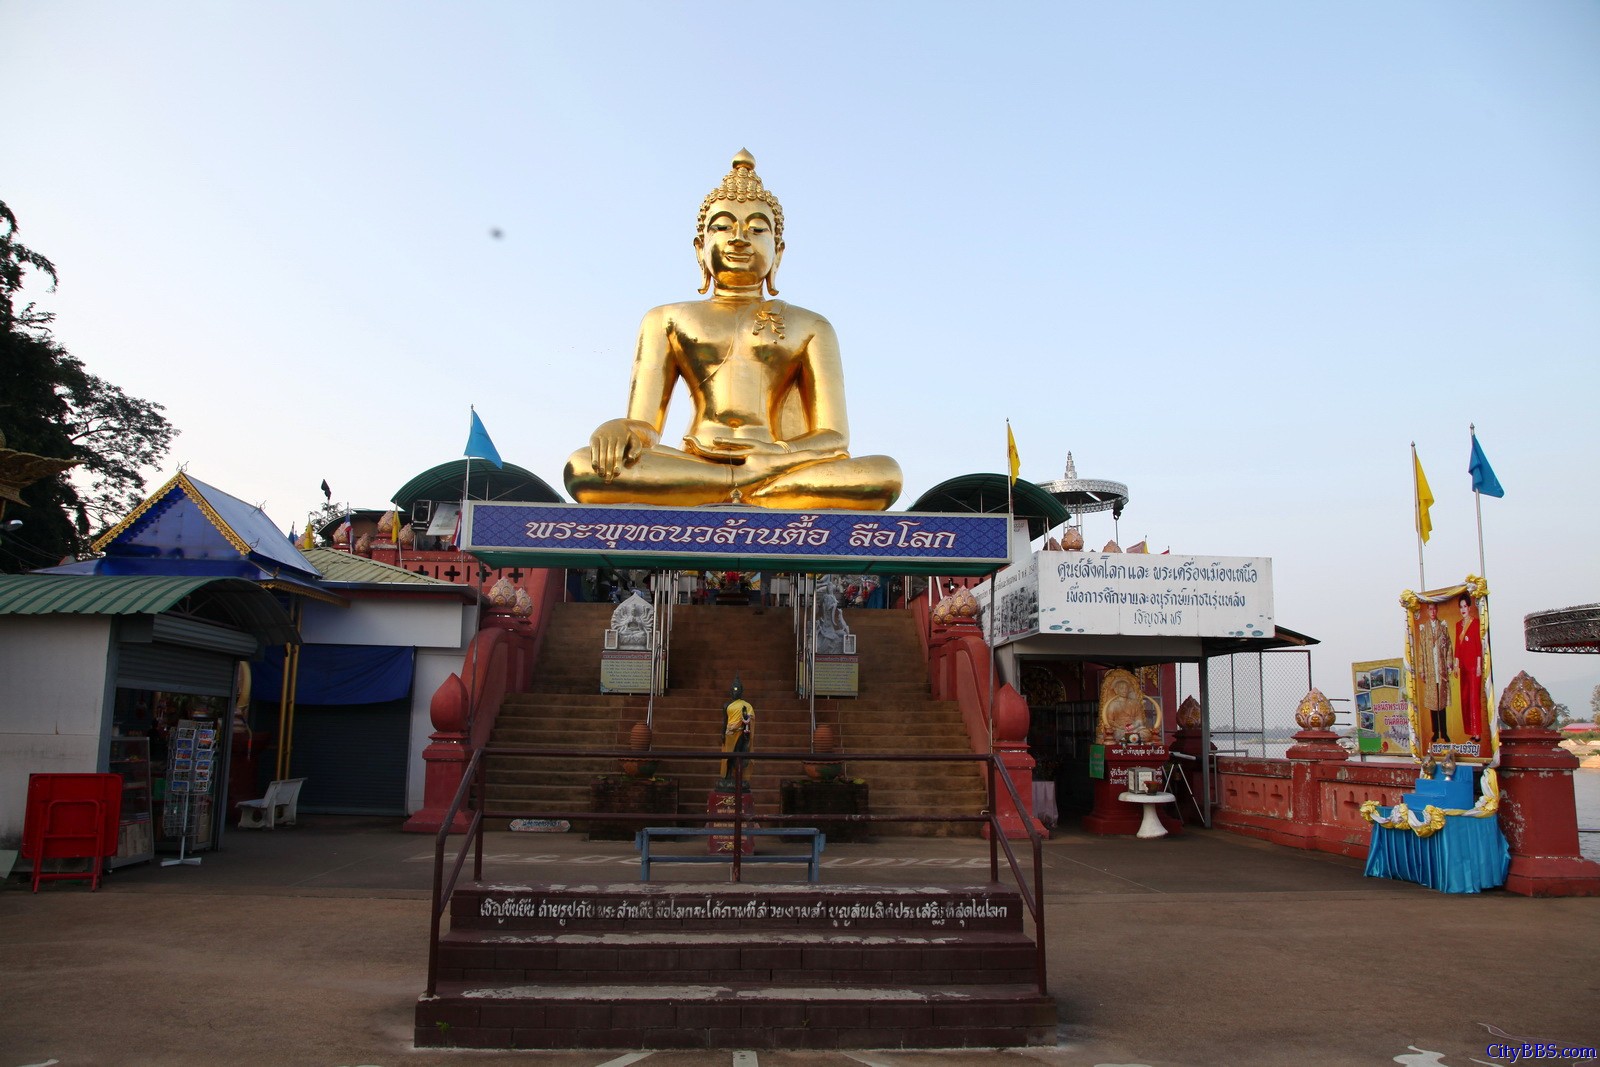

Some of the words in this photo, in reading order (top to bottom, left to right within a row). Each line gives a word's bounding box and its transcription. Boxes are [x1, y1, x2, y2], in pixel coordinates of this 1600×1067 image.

[525, 514, 830, 550] พระพุทธนวล้านตื้อ
[849, 520, 957, 550] ลือโลก
[1153, 557, 1258, 584] พระเครื่องเมืองเหนือ
